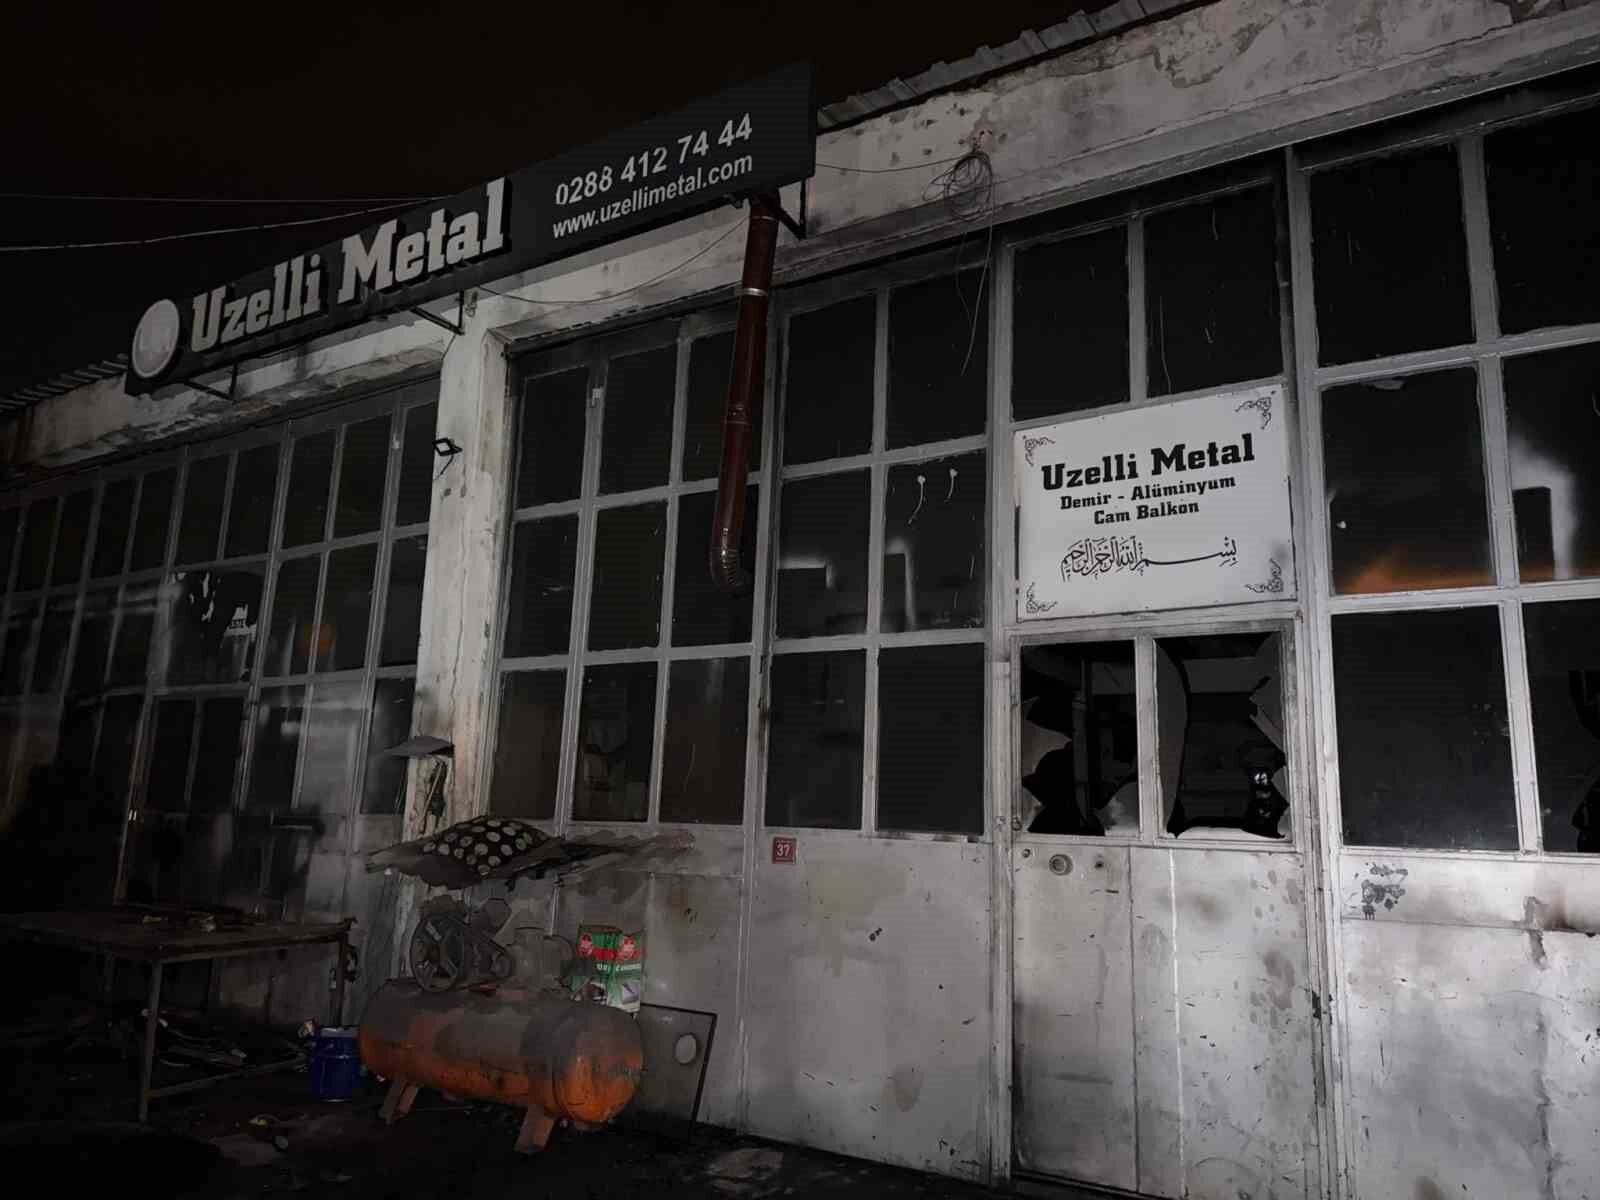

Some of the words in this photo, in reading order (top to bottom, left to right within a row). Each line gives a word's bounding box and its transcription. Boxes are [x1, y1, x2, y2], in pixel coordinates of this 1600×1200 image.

[556, 165, 613, 205] 0288
[620, 147, 668, 182] 412
[677, 130, 709, 164] 74
[718, 112, 753, 147] 44
[553, 154, 753, 239] www.uzellimetal.com
[191, 253, 322, 353] Uzelli
[337, 177, 506, 304] Metal
[1041, 452, 1139, 491] Uzelli
[1150, 432, 1255, 476] Metal
[1060, 492, 1112, 510] Demir
[1130, 476, 1237, 502] Alüminyum
[1094, 509, 1131, 525] Cam
[1136, 500, 1200, 520] Balkon
[776, 843, 791, 857] 37
